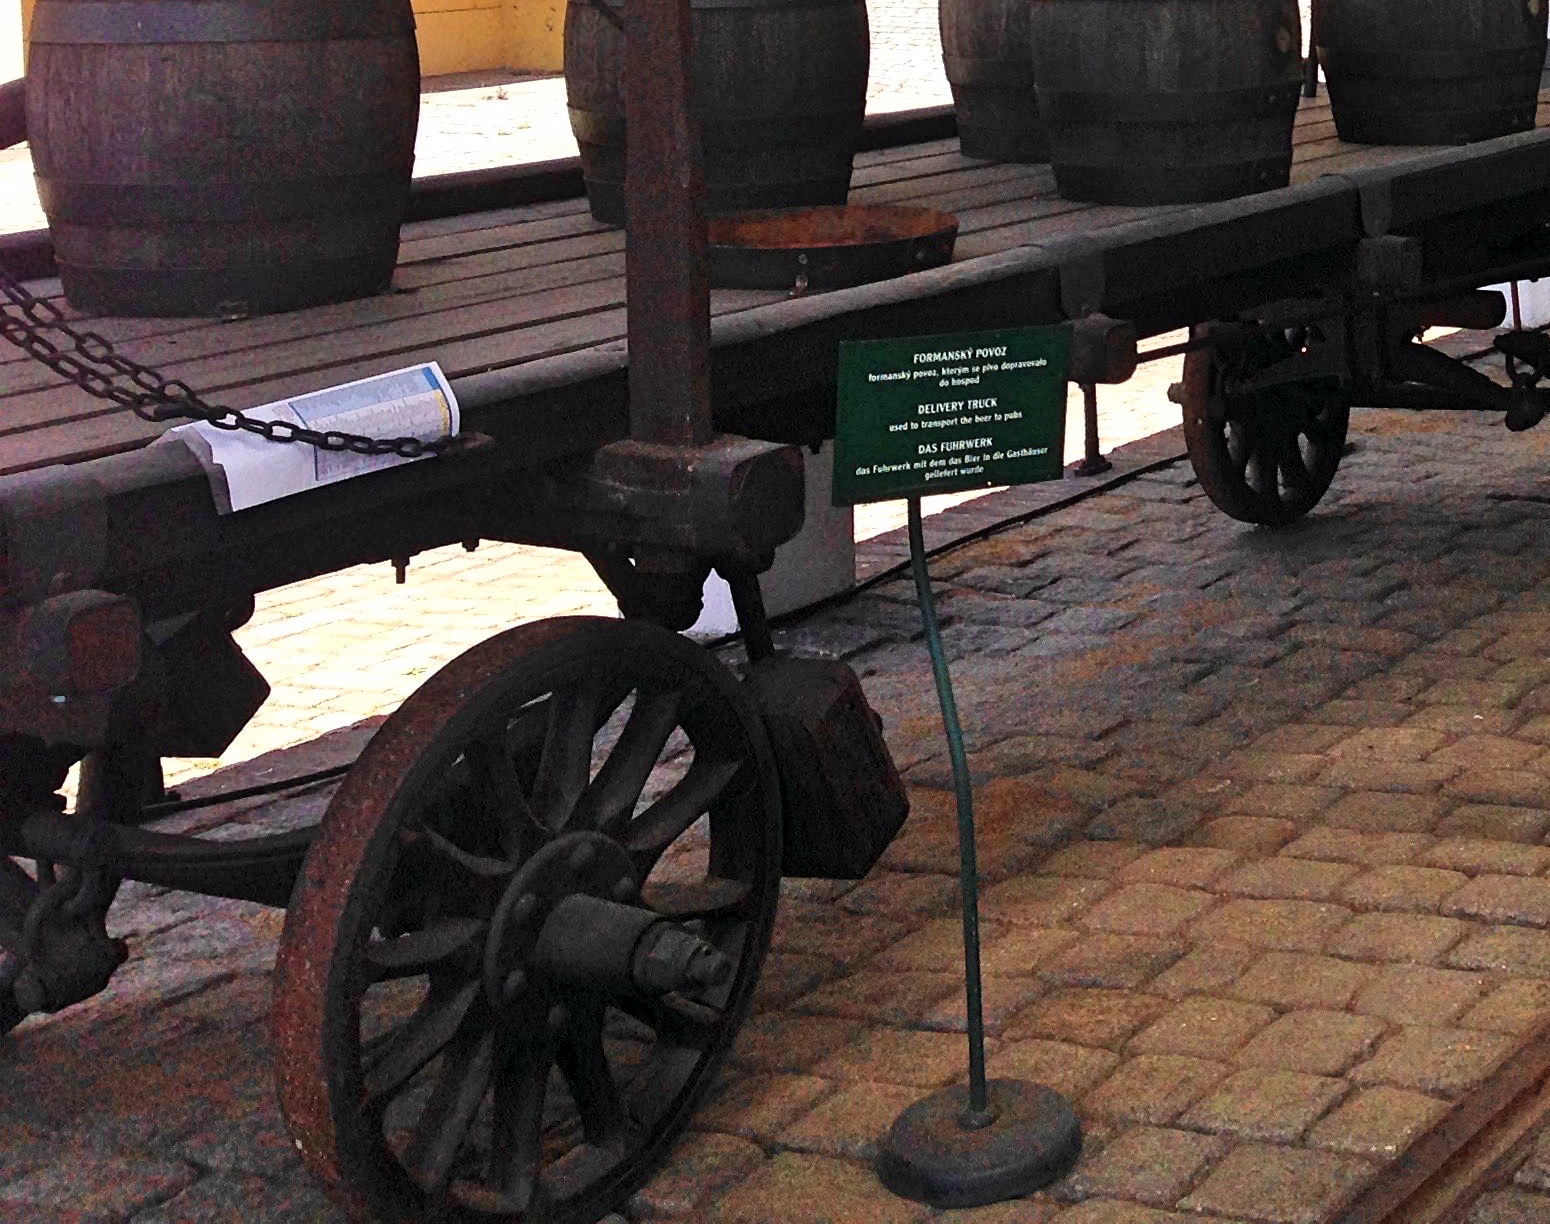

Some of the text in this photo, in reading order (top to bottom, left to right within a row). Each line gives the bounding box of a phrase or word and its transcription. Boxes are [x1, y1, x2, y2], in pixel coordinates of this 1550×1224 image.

[913, 346, 1007, 364] FORMANSKÝ POVOZ
[917, 397, 998, 415] DELIVERY TRUCK
[889, 411, 1023, 432] used to transport the beer to pubs
[917, 437, 993, 454] DAS FUHRWERK
[855, 466, 871, 476] das
[872, 461, 911, 474] Fuhrwerk
[913, 460, 928, 470] mit
[929, 458, 946, 468] dem
[948, 456, 963, 466] das
[964, 454, 981, 464] Bier
[983, 453, 991, 462] in
[992, 451, 1005, 461] die
[924, 465, 985, 480] geliefert wurde
